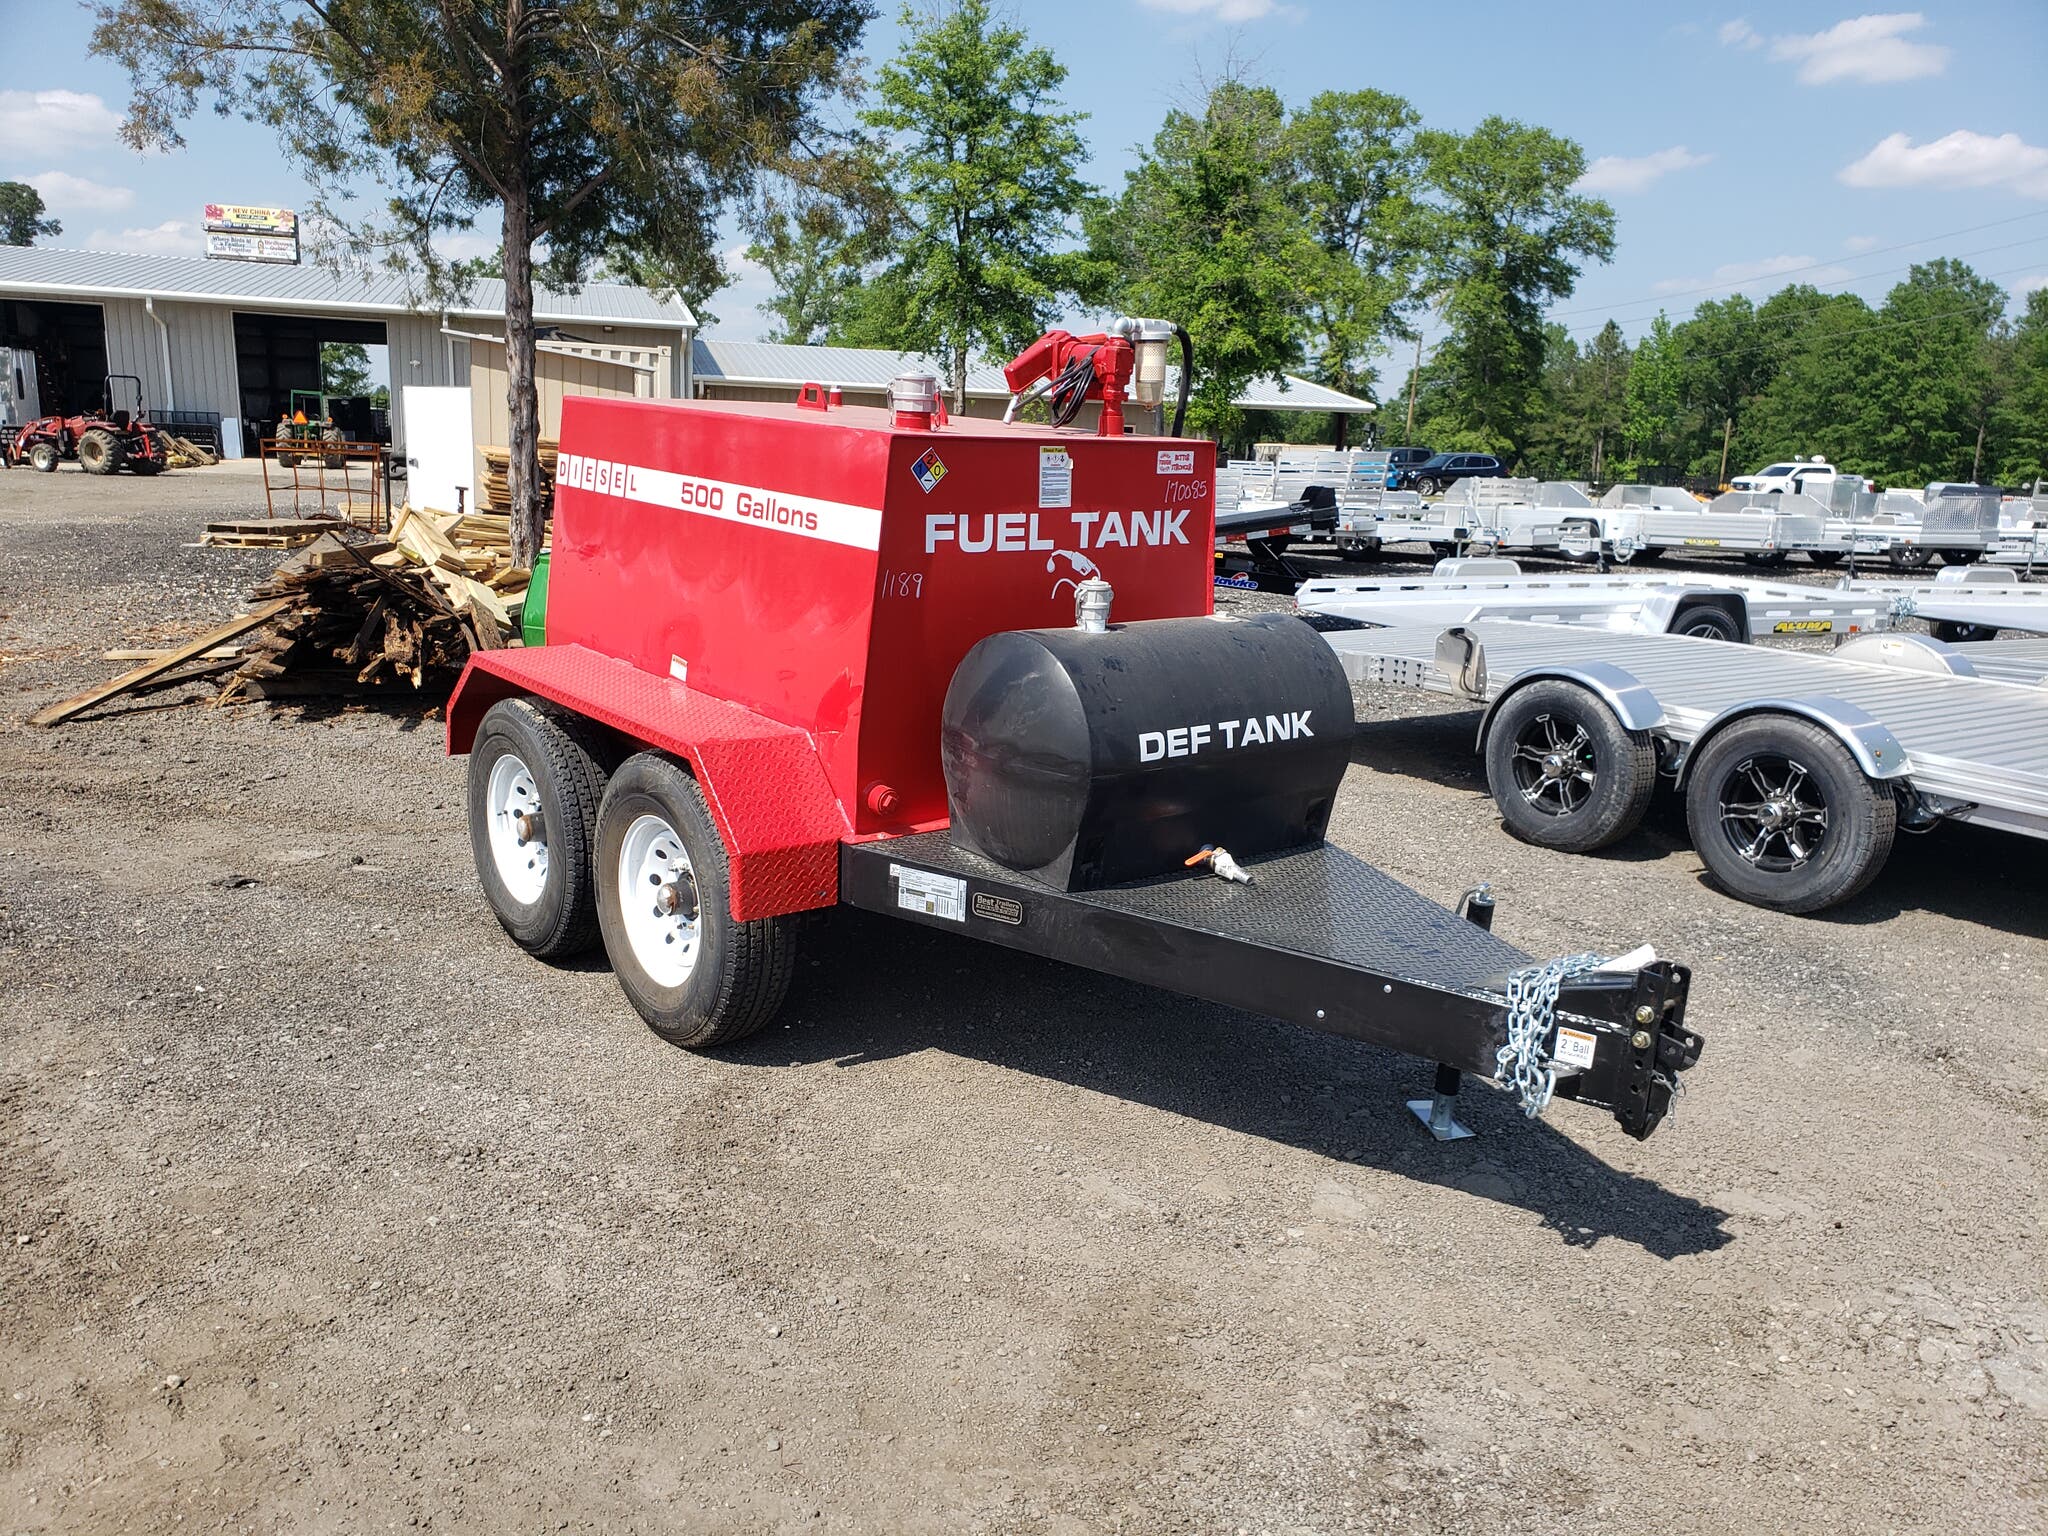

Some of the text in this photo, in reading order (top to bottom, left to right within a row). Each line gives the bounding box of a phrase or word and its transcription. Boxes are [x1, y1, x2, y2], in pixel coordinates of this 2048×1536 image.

[249, 208, 271, 216] CHINA
[927, 454, 933, 464] 2
[934, 465, 941, 476] 0
[559, 460, 818, 531] DIESEL 500 Gallons
[1164, 479, 1207, 503] 170085
[925, 509, 1191, 553] FUEL TANK
[881, 568, 924, 599] 1189
[1774, 621, 1832, 633] ALUMA
[1138, 710, 1314, 762] DEF TANK
[977, 895, 995, 906] Best
[1573, 1041, 1590, 1054] Ball
